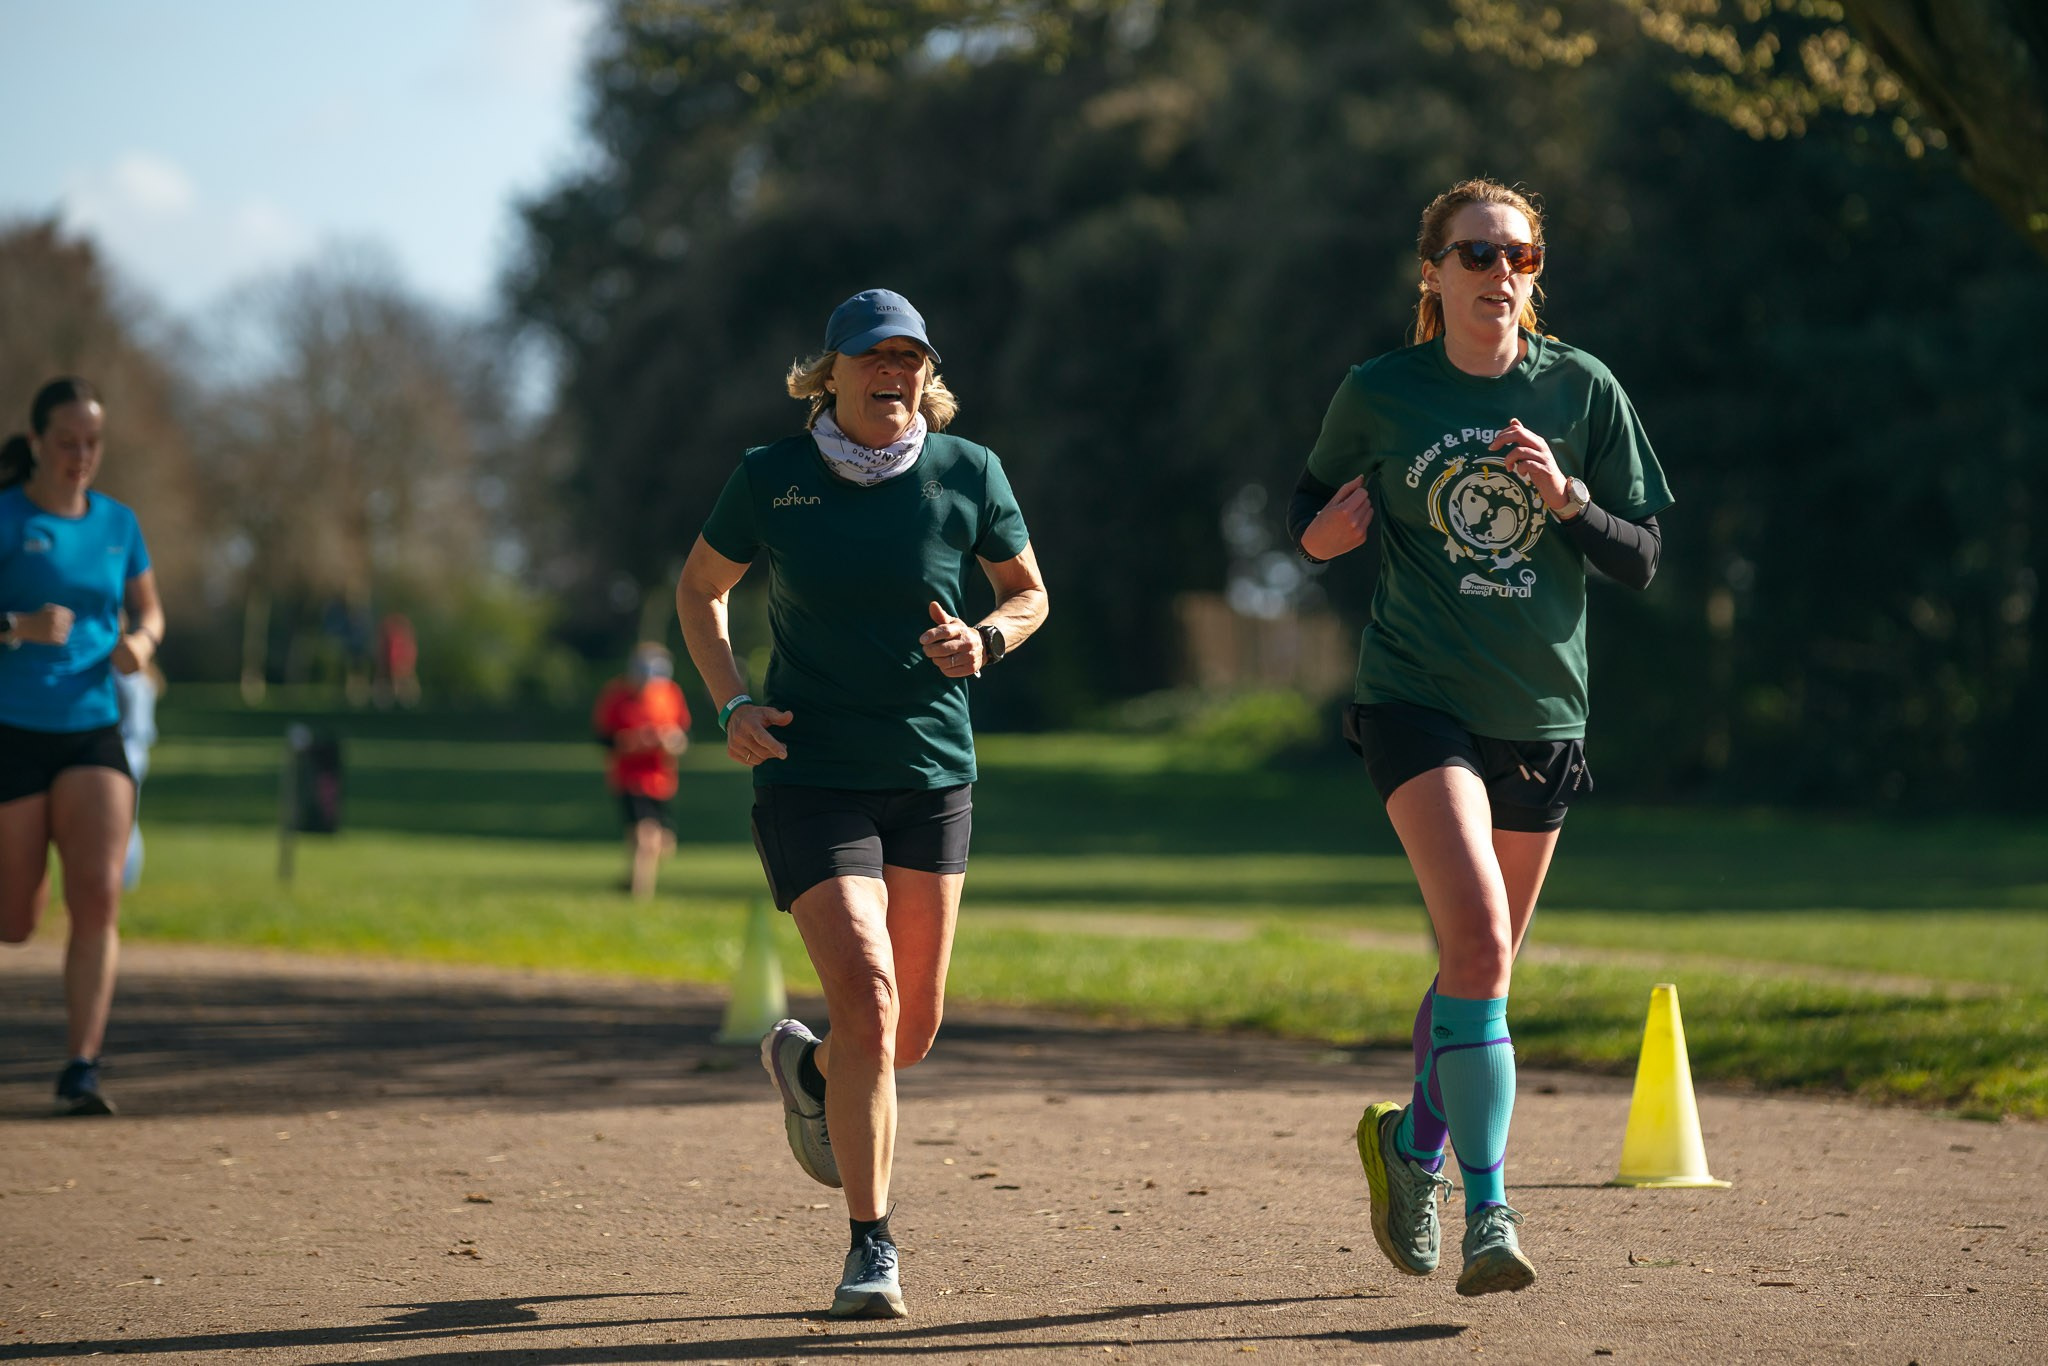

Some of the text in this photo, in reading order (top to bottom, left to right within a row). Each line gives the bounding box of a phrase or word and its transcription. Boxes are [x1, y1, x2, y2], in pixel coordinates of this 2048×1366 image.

[1406, 442, 1442, 488] Cider
[1443, 433, 1460, 448] &
[773, 485, 821, 509] parkrun
[1460, 589, 1489, 597] running
[1488, 576, 1532, 598] rural
